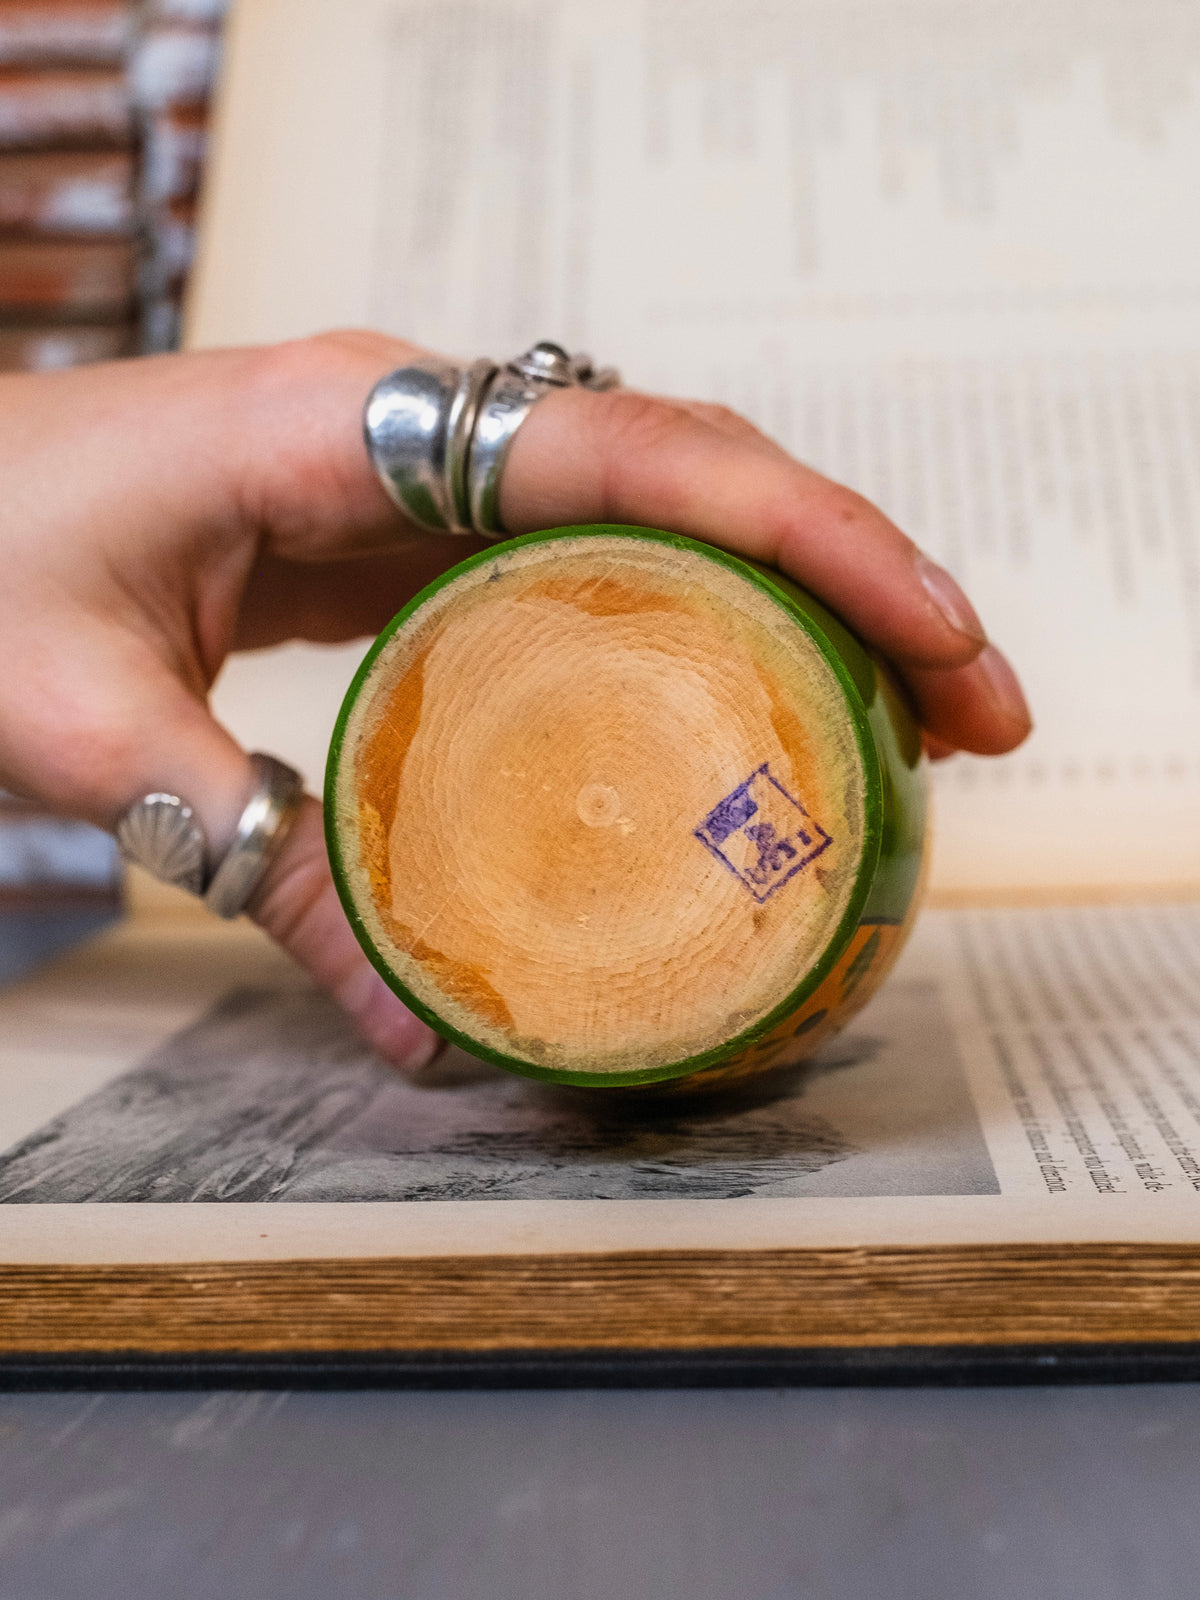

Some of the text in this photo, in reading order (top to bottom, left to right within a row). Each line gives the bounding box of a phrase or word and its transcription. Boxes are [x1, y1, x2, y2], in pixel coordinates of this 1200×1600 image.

[1084, 1156, 1111, 1170] who
[1134, 1163, 1166, 1180] while
[1040, 1165, 1073, 1193] direction.
[1089, 1170, 1127, 1193] utilized
[1144, 1182, 1173, 1193] de-
